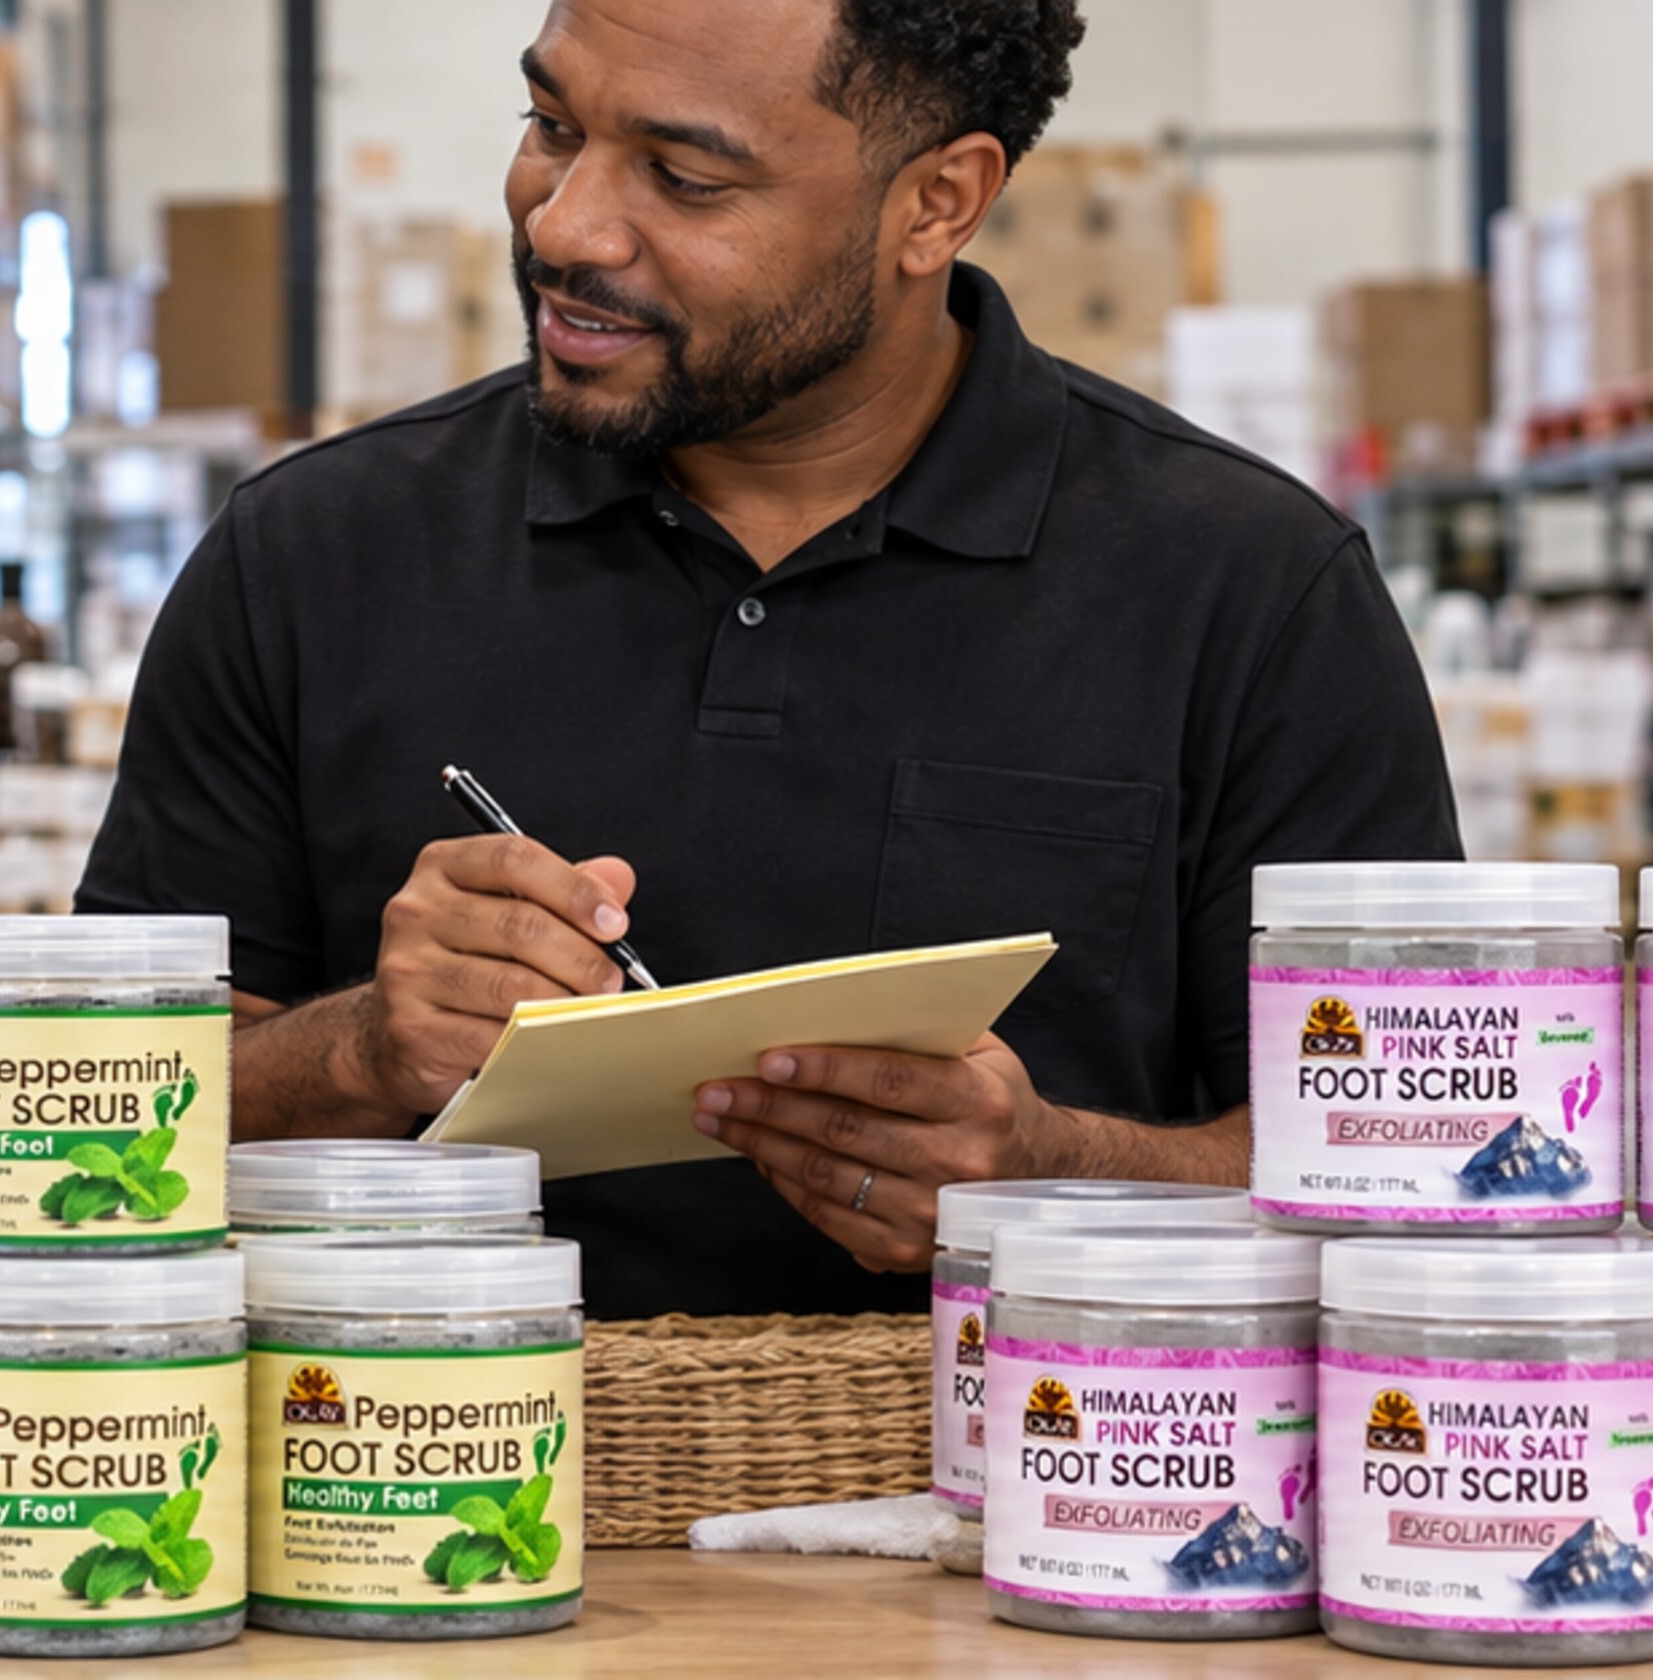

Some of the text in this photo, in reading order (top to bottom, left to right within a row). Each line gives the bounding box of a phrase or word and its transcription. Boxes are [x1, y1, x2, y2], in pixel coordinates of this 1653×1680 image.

[1366, 1007, 1518, 1030] HIMALAYAN
[1383, 1036, 1517, 1059] PINK SALT
[1300, 1067, 1517, 1099] FOOT SCRUB
[13, 1093, 140, 1123] SCRUB
[1338, 1119, 1488, 1141] EXFOLIATING
[955, 1374, 984, 1407] FO
[1082, 1390, 1235, 1415] HIMALAYAN
[354, 1392, 555, 1436] Peppermint
[1428, 1403, 1588, 1429] HIMALAYAN
[1097, 1420, 1159, 1445] PINK
[1171, 1421, 1235, 1447] SALT
[1445, 1433, 1510, 1459] PINK
[1521, 1434, 1588, 1460] SALT
[32, 1454, 166, 1488] SCRUB
[284, 1438, 521, 1476] FOOT SCRUB
[1022, 1448, 1234, 1488] FOOT SCRUB
[1364, 1462, 1588, 1501] FOOT SCRUB
[1055, 1501, 1201, 1530] EXFOLIATING
[1400, 1518, 1555, 1546] EXFOLIATING
